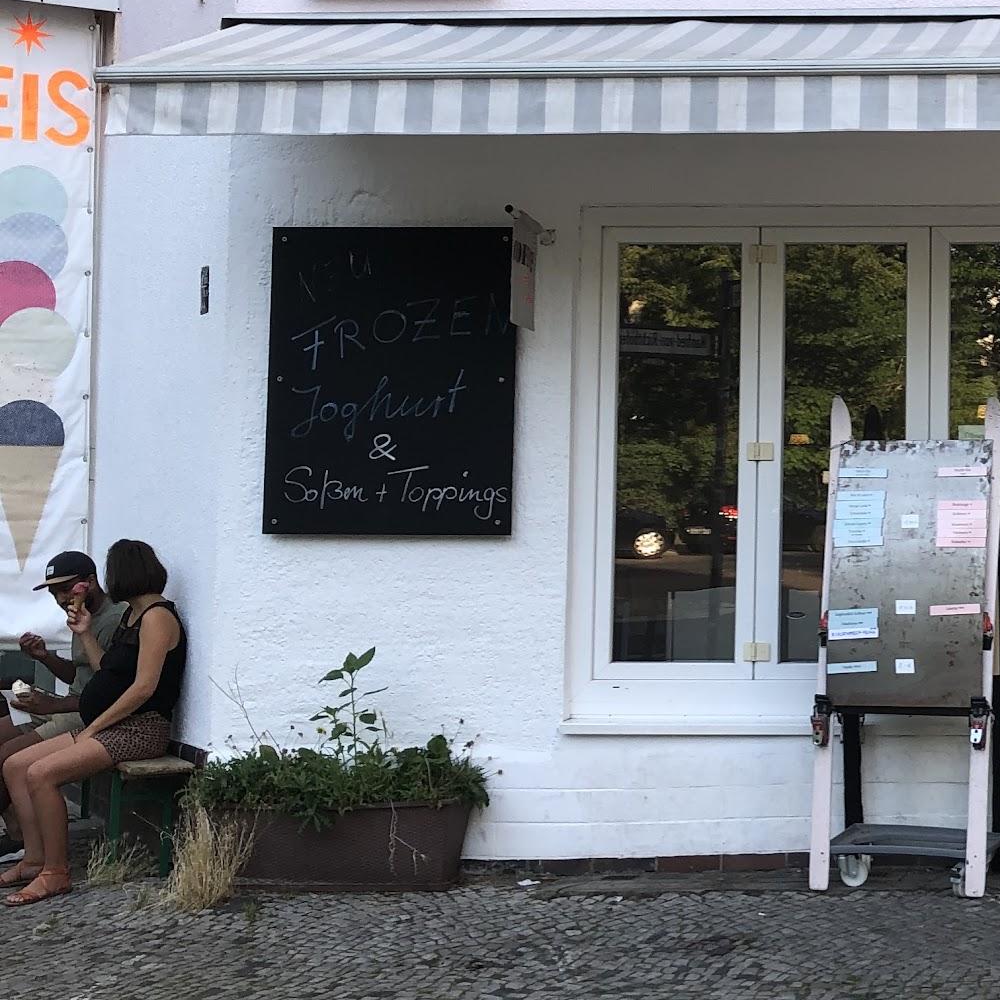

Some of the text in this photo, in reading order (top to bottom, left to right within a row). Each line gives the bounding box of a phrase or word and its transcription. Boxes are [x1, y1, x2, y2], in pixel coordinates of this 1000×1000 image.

[290, 368, 468, 443] Joghurt
[368, 433, 398, 461] &
[387, 465, 509, 520] Toppings
